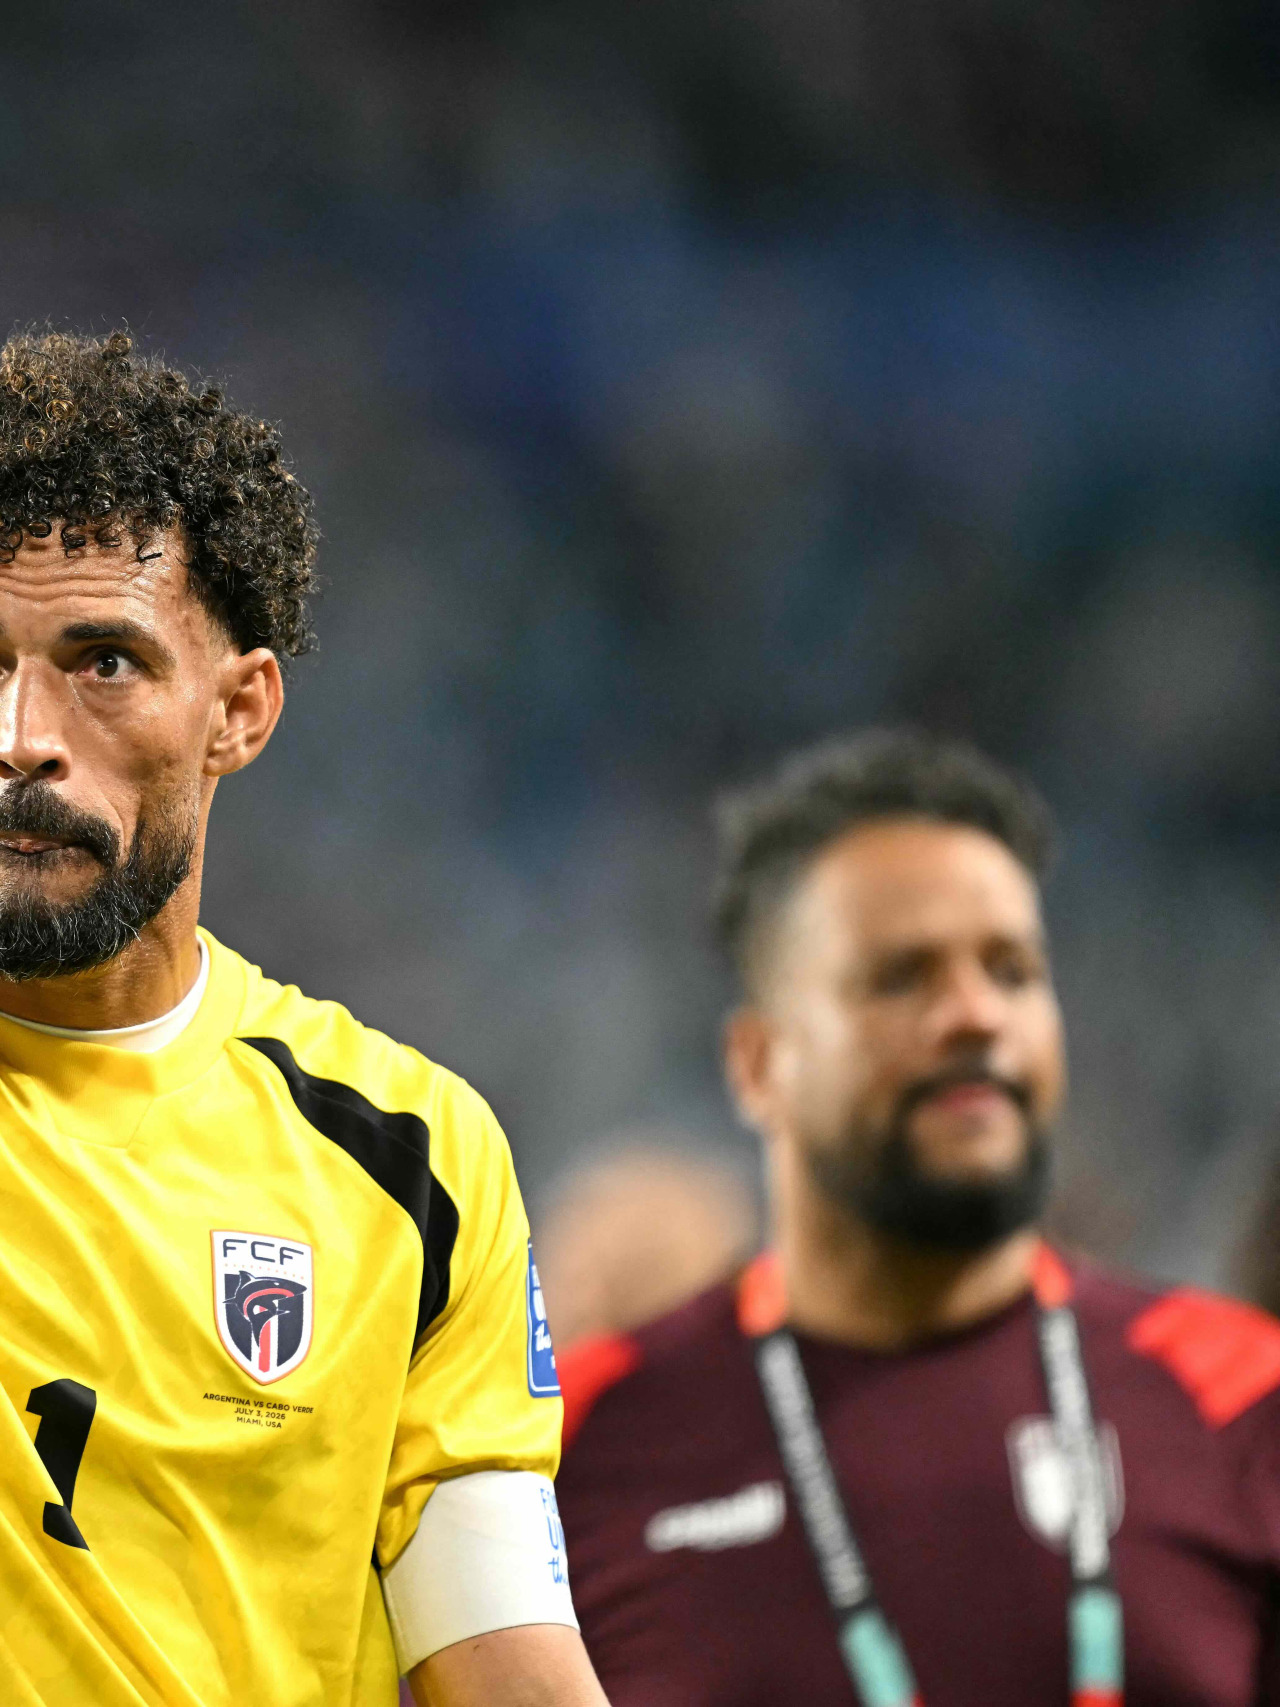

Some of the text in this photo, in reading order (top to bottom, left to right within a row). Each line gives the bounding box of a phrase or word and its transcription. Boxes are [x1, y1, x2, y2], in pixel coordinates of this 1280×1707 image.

[223, 1239, 304, 1265] FCF
[203, 1393, 251, 1406] ARGENTINA
[253, 1400, 264, 1408] VS
[266, 1402, 290, 1411] CABO
[234, 1407, 286, 1420] JULY 3, 2026
[237, 1417, 282, 1429] MIAMI, USA
[25, 1378, 98, 1551] 1
